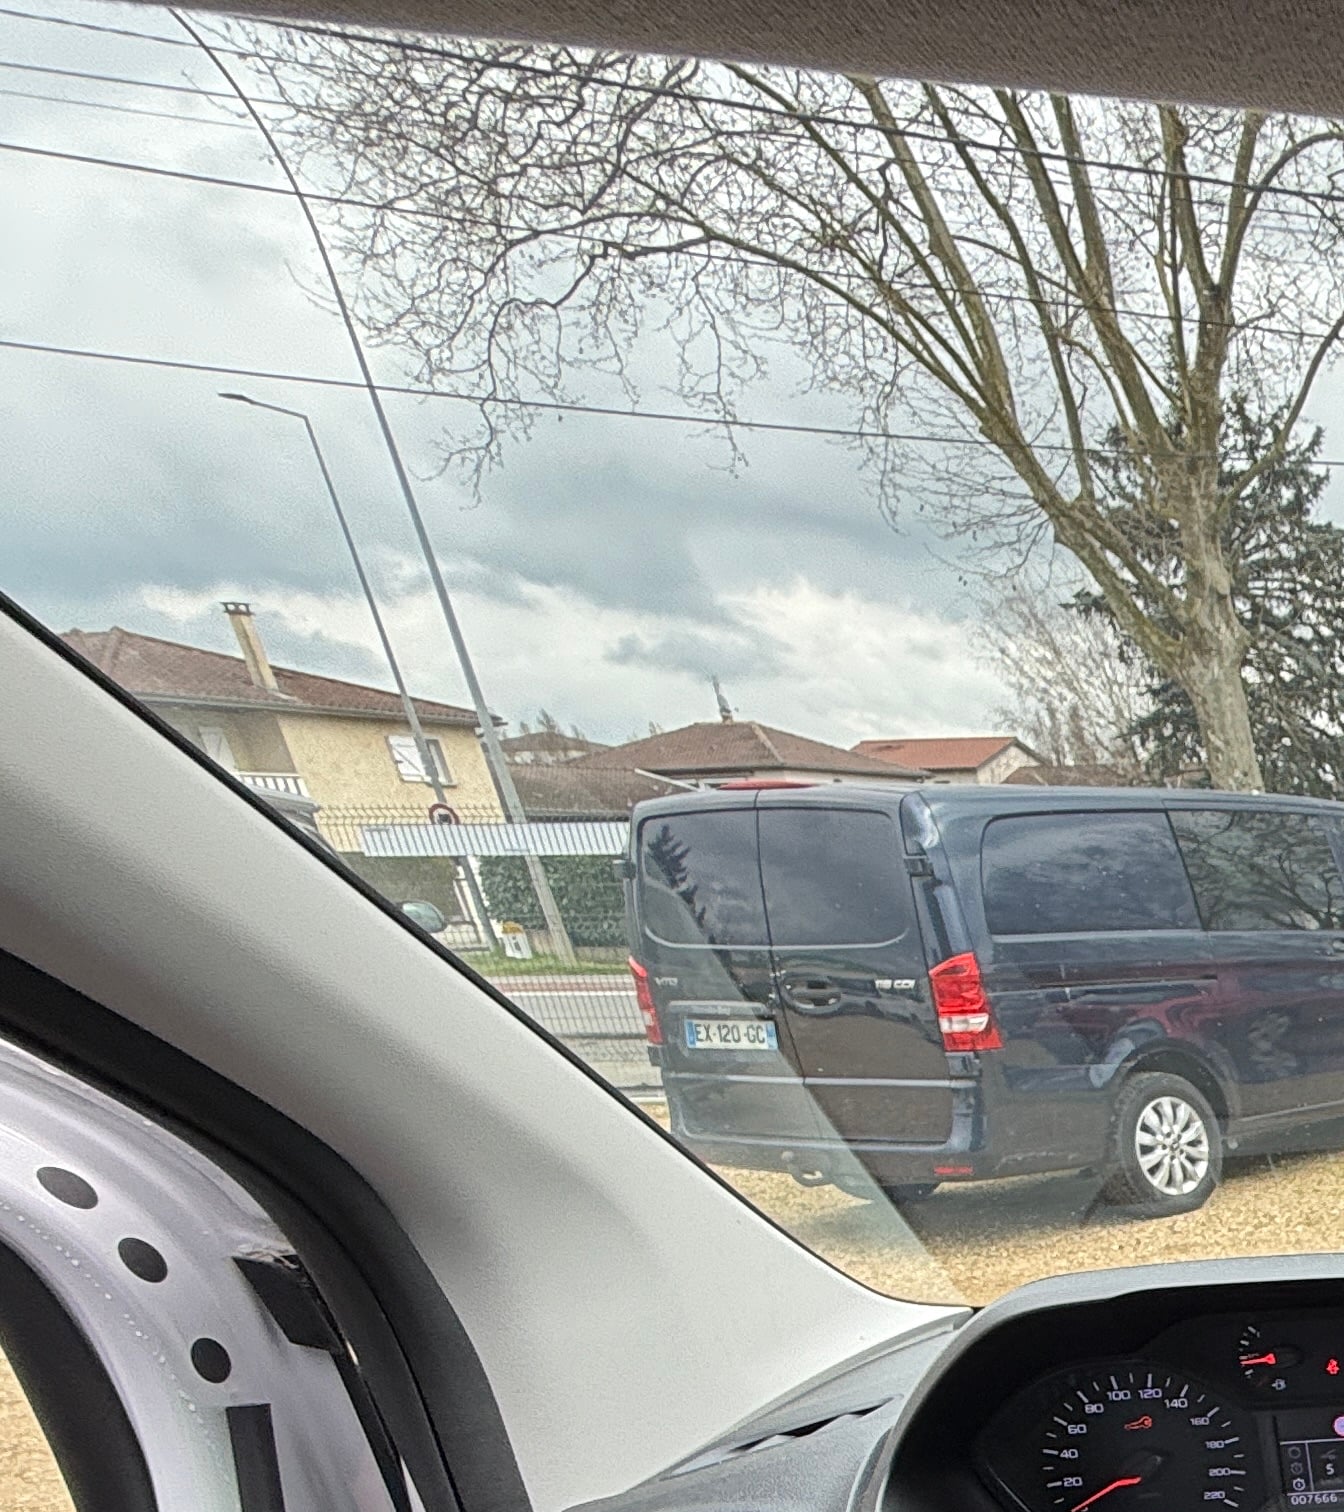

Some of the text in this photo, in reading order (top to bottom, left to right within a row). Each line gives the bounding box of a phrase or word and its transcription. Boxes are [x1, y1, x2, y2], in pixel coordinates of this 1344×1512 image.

[694, 1023, 766, 1044] EX-120-GC
[1106, 1390, 1131, 1400] 100
[1138, 1388, 1163, 1400] 120
[1084, 1403, 1105, 1414] 80
[1164, 1398, 1188, 1409] 140
[1189, 1417, 1210, 1426] 160
[1067, 1423, 1087, 1435] 60
[1205, 1440, 1225, 1449] 180
[1059, 1448, 1079, 1459] 40
[1208, 1467, 1231, 1476] 200
[1325, 1464, 1335, 1475] 5
[1063, 1477, 1083, 1487] 20
[1203, 1491, 1226, 1500] 220
[1290, 1493, 1338, 1505] 007666
